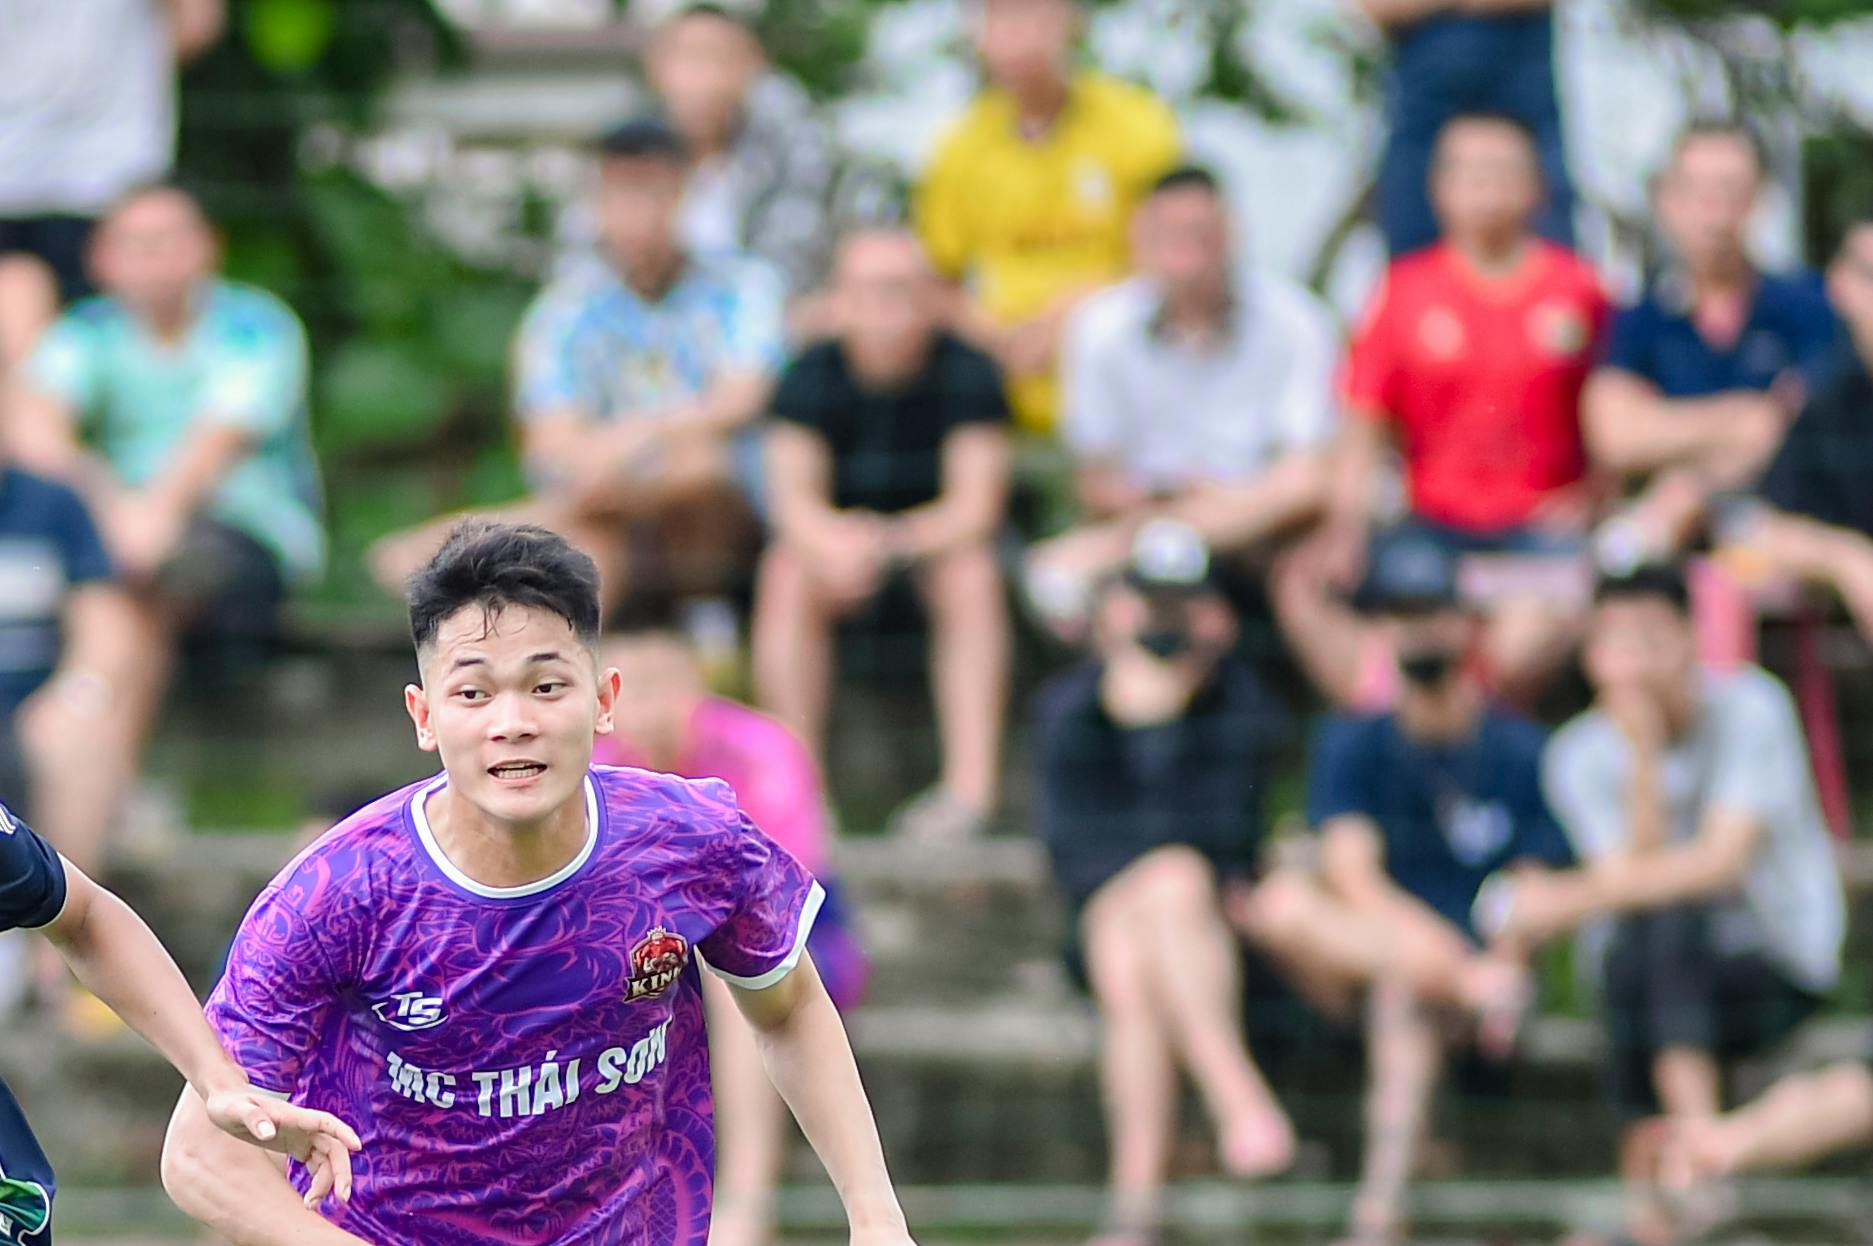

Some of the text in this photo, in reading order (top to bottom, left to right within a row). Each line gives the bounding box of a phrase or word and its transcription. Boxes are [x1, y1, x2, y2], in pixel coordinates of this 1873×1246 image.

[631, 965, 682, 997] KIN
[391, 991, 444, 1025] TS
[471, 1049, 581, 1118] THÁI
